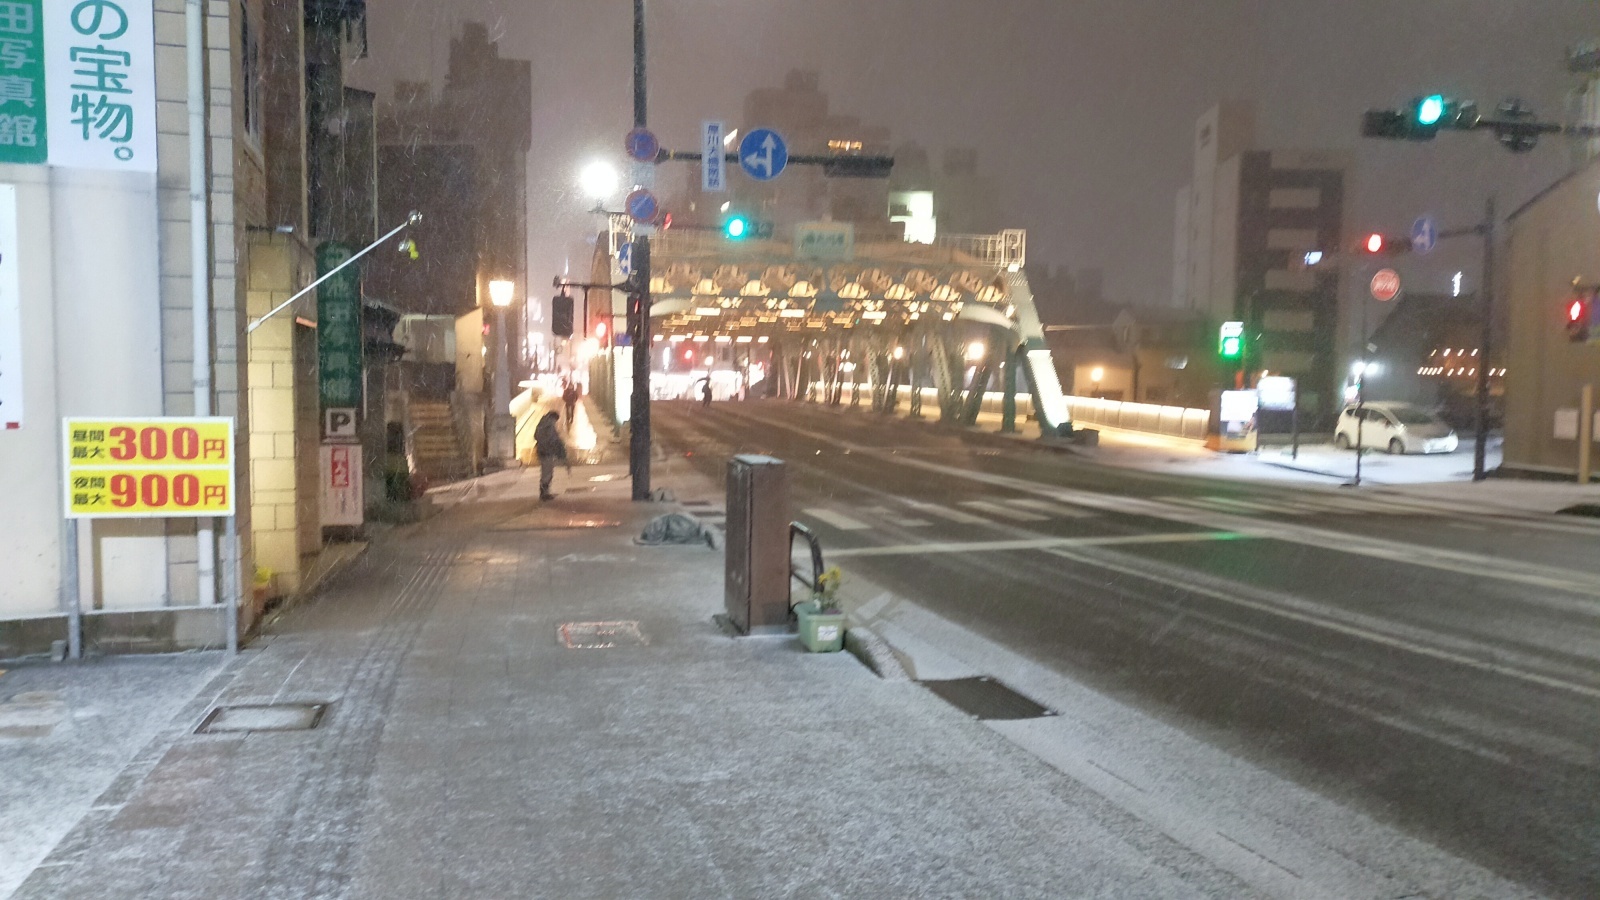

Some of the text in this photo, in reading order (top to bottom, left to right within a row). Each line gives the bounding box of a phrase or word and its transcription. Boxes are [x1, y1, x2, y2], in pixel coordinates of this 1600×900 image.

[70, 0, 134, 161] の宝物。
[330, 412, 351, 432] P
[72, 429, 105, 442] 昼間
[109, 426, 226, 461] 300円
[72, 445, 105, 459] 最大
[73, 476, 106, 489] 夜間
[110, 473, 226, 508] 900円
[73, 492, 106, 506] 最大
